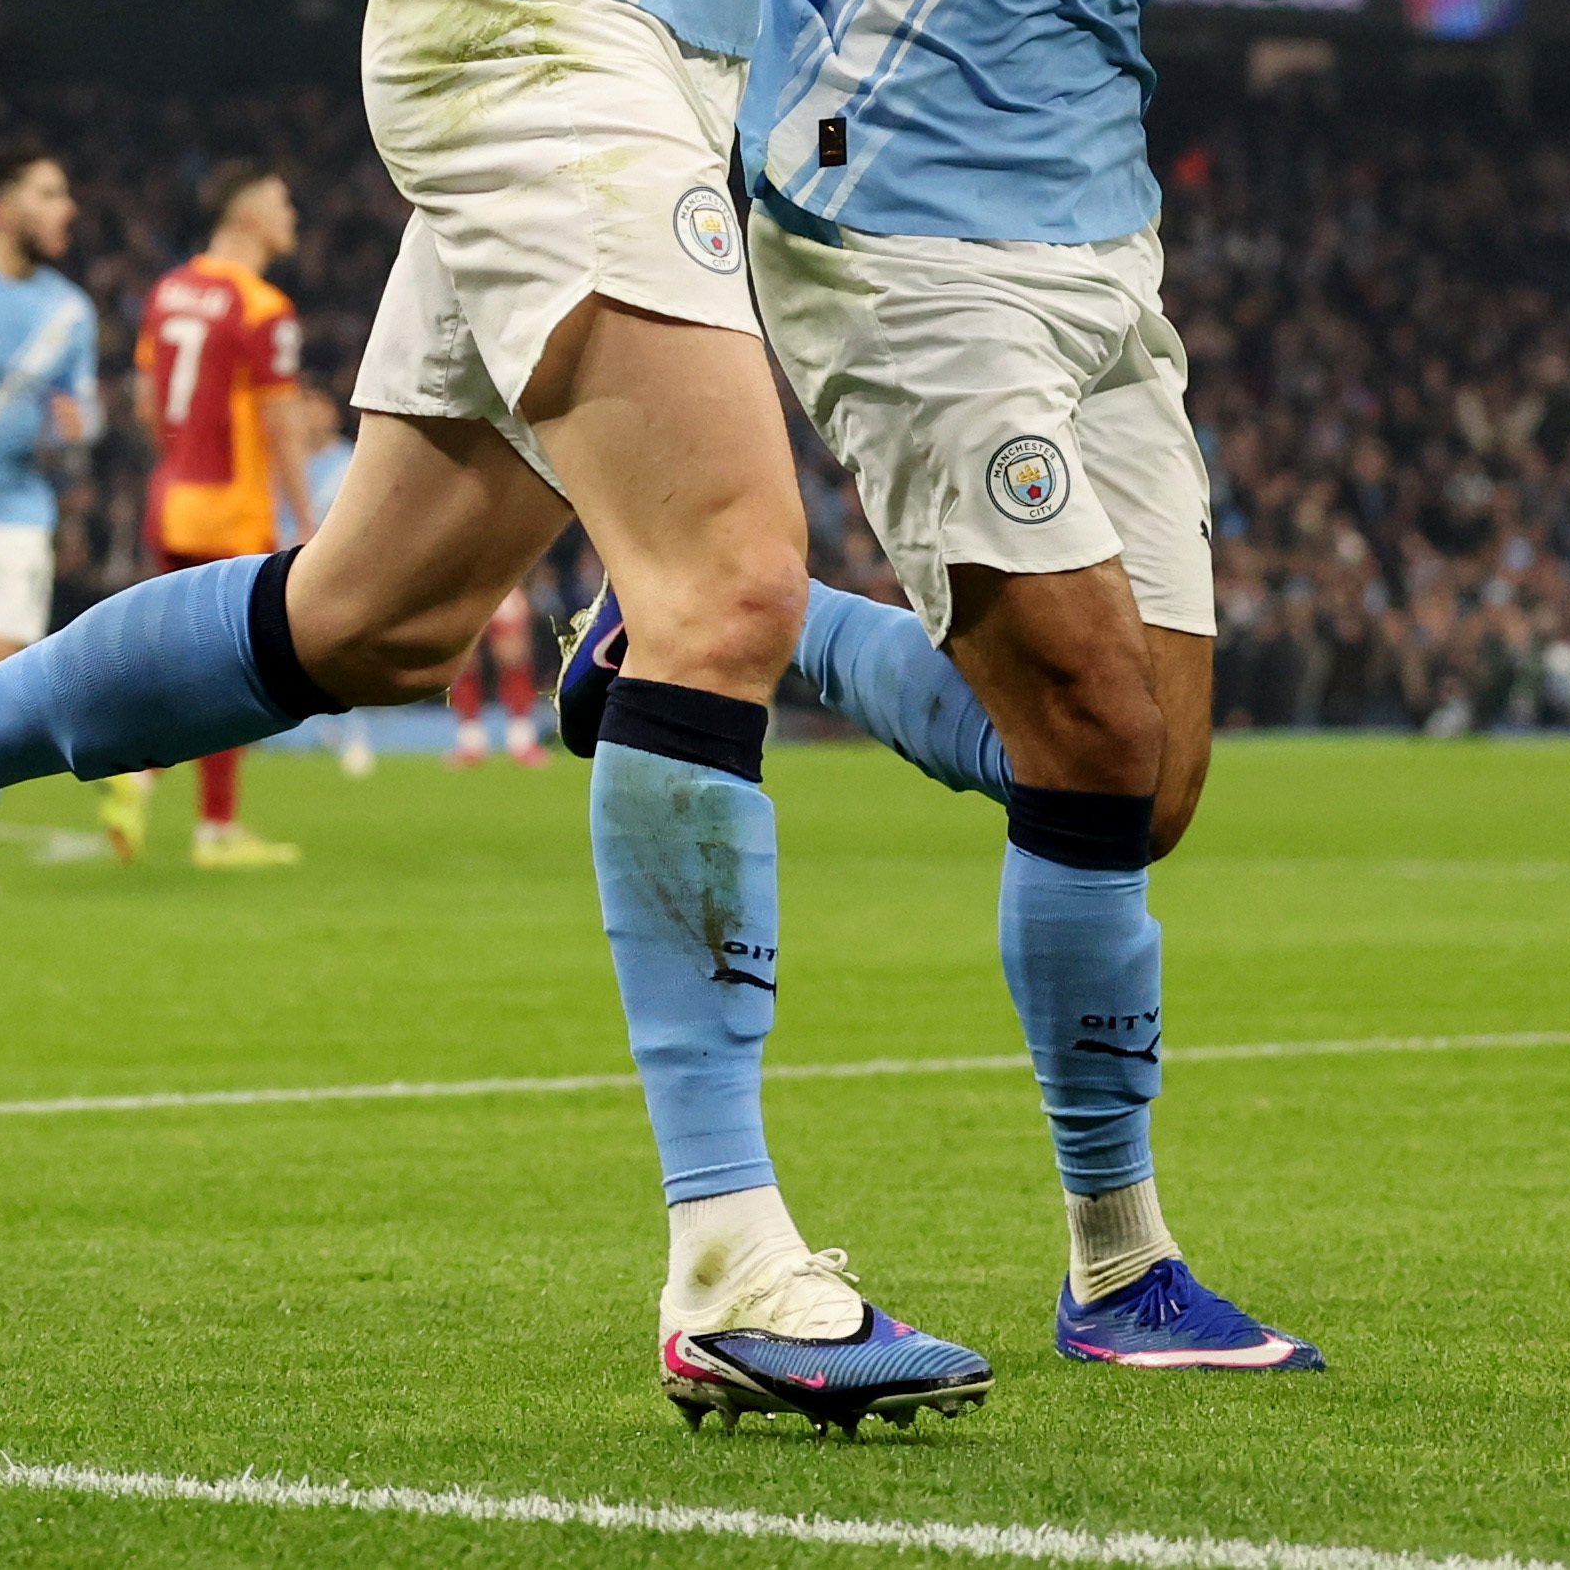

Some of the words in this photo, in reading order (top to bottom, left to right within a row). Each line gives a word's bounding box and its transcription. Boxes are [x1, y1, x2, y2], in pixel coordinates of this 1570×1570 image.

[680, 193, 732, 222] MANCHESTER
[712, 259, 731, 268] CITY
[160, 316, 208, 423] 7
[993, 442, 1057, 479] MANCHESTER
[1029, 504, 1052, 518] CITY
